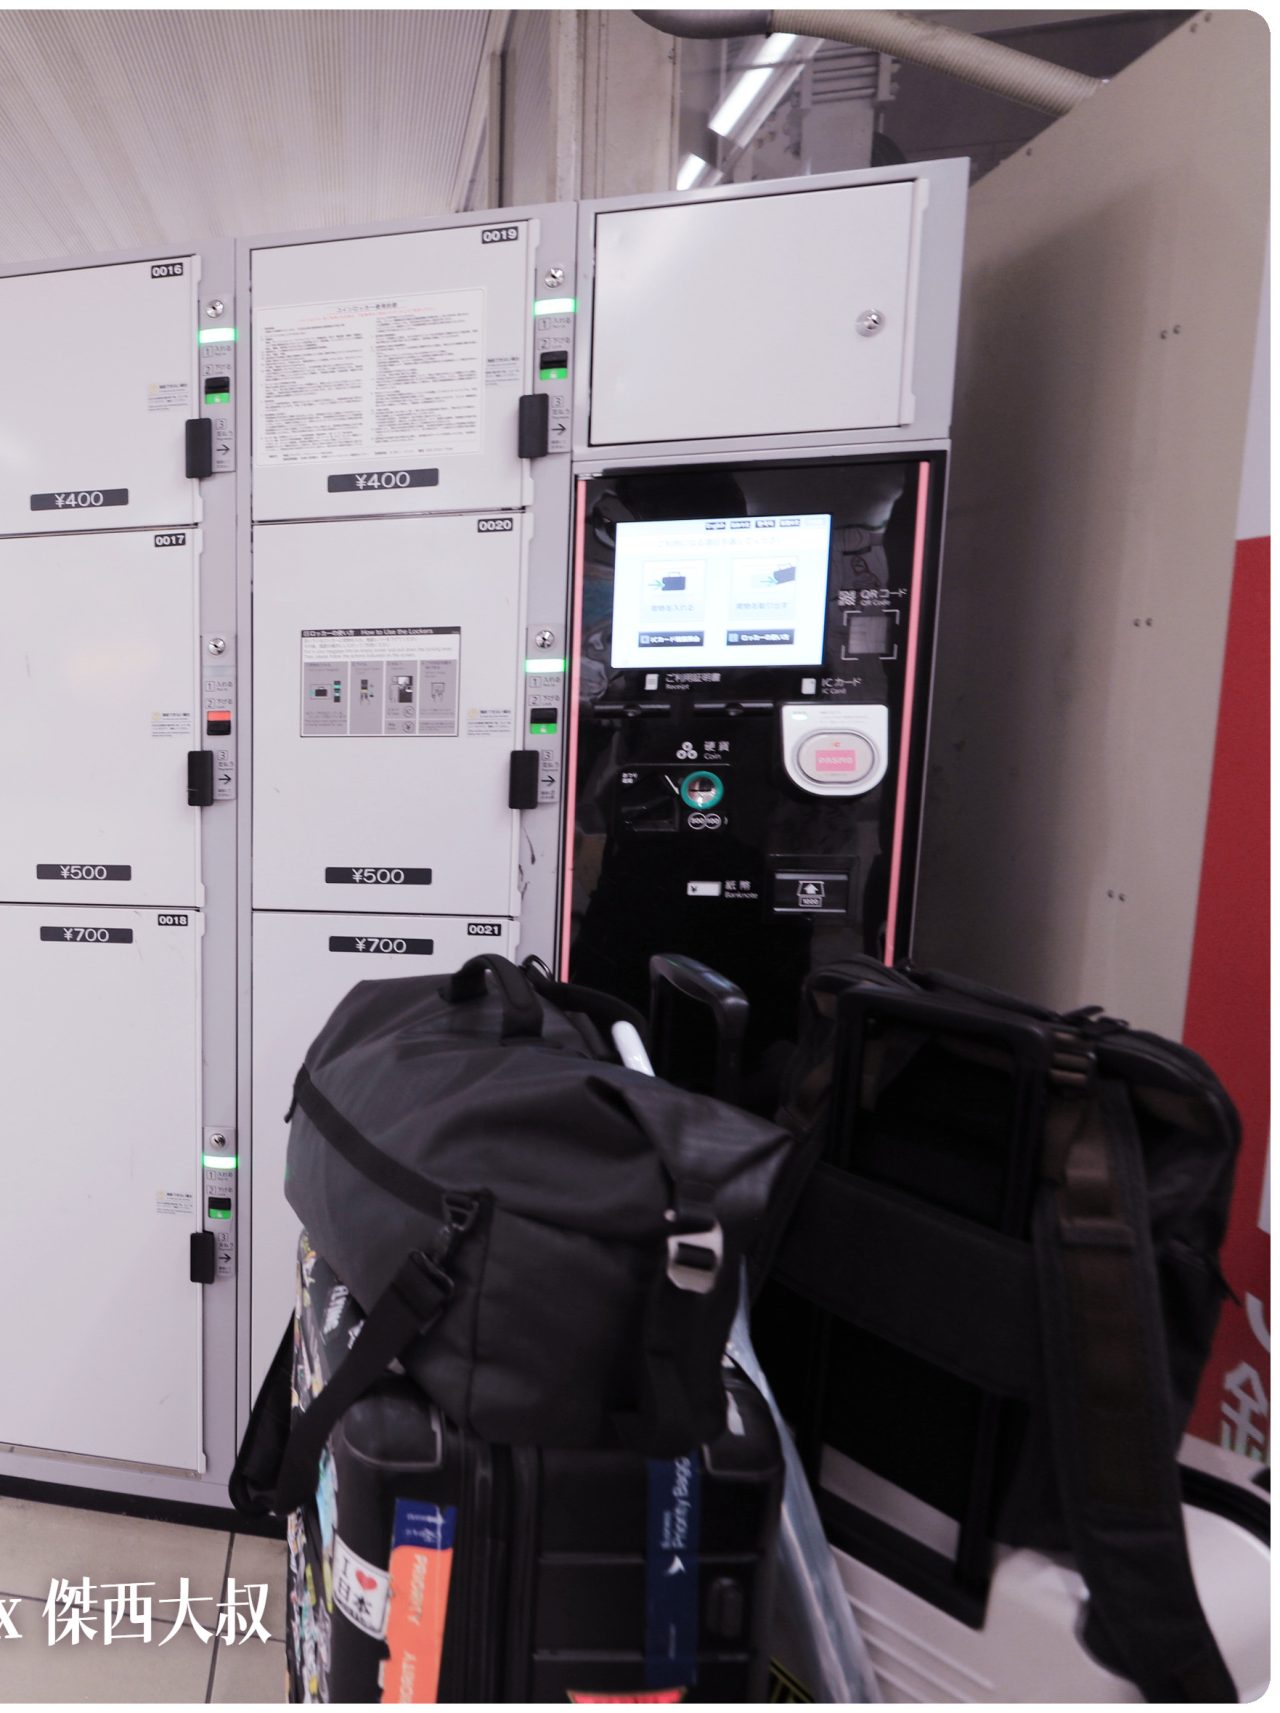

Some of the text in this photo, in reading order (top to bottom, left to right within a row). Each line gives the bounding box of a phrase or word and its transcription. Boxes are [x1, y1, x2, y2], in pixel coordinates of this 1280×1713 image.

[482, 228, 517, 243] 0019
[152, 264, 182, 278] 0016
[355, 471, 410, 490] ¥400
[55, 491, 103, 508] ¥400
[478, 519, 511, 532] 0020
[155, 535, 185, 547] 0017
[60, 866, 106, 880] ¥500
[352, 869, 405, 884] ¥500
[159, 915, 187, 926] 0018
[64, 928, 109, 942] ¥700
[468, 924, 501, 936] 0021
[356, 938, 407, 954] ¥700
